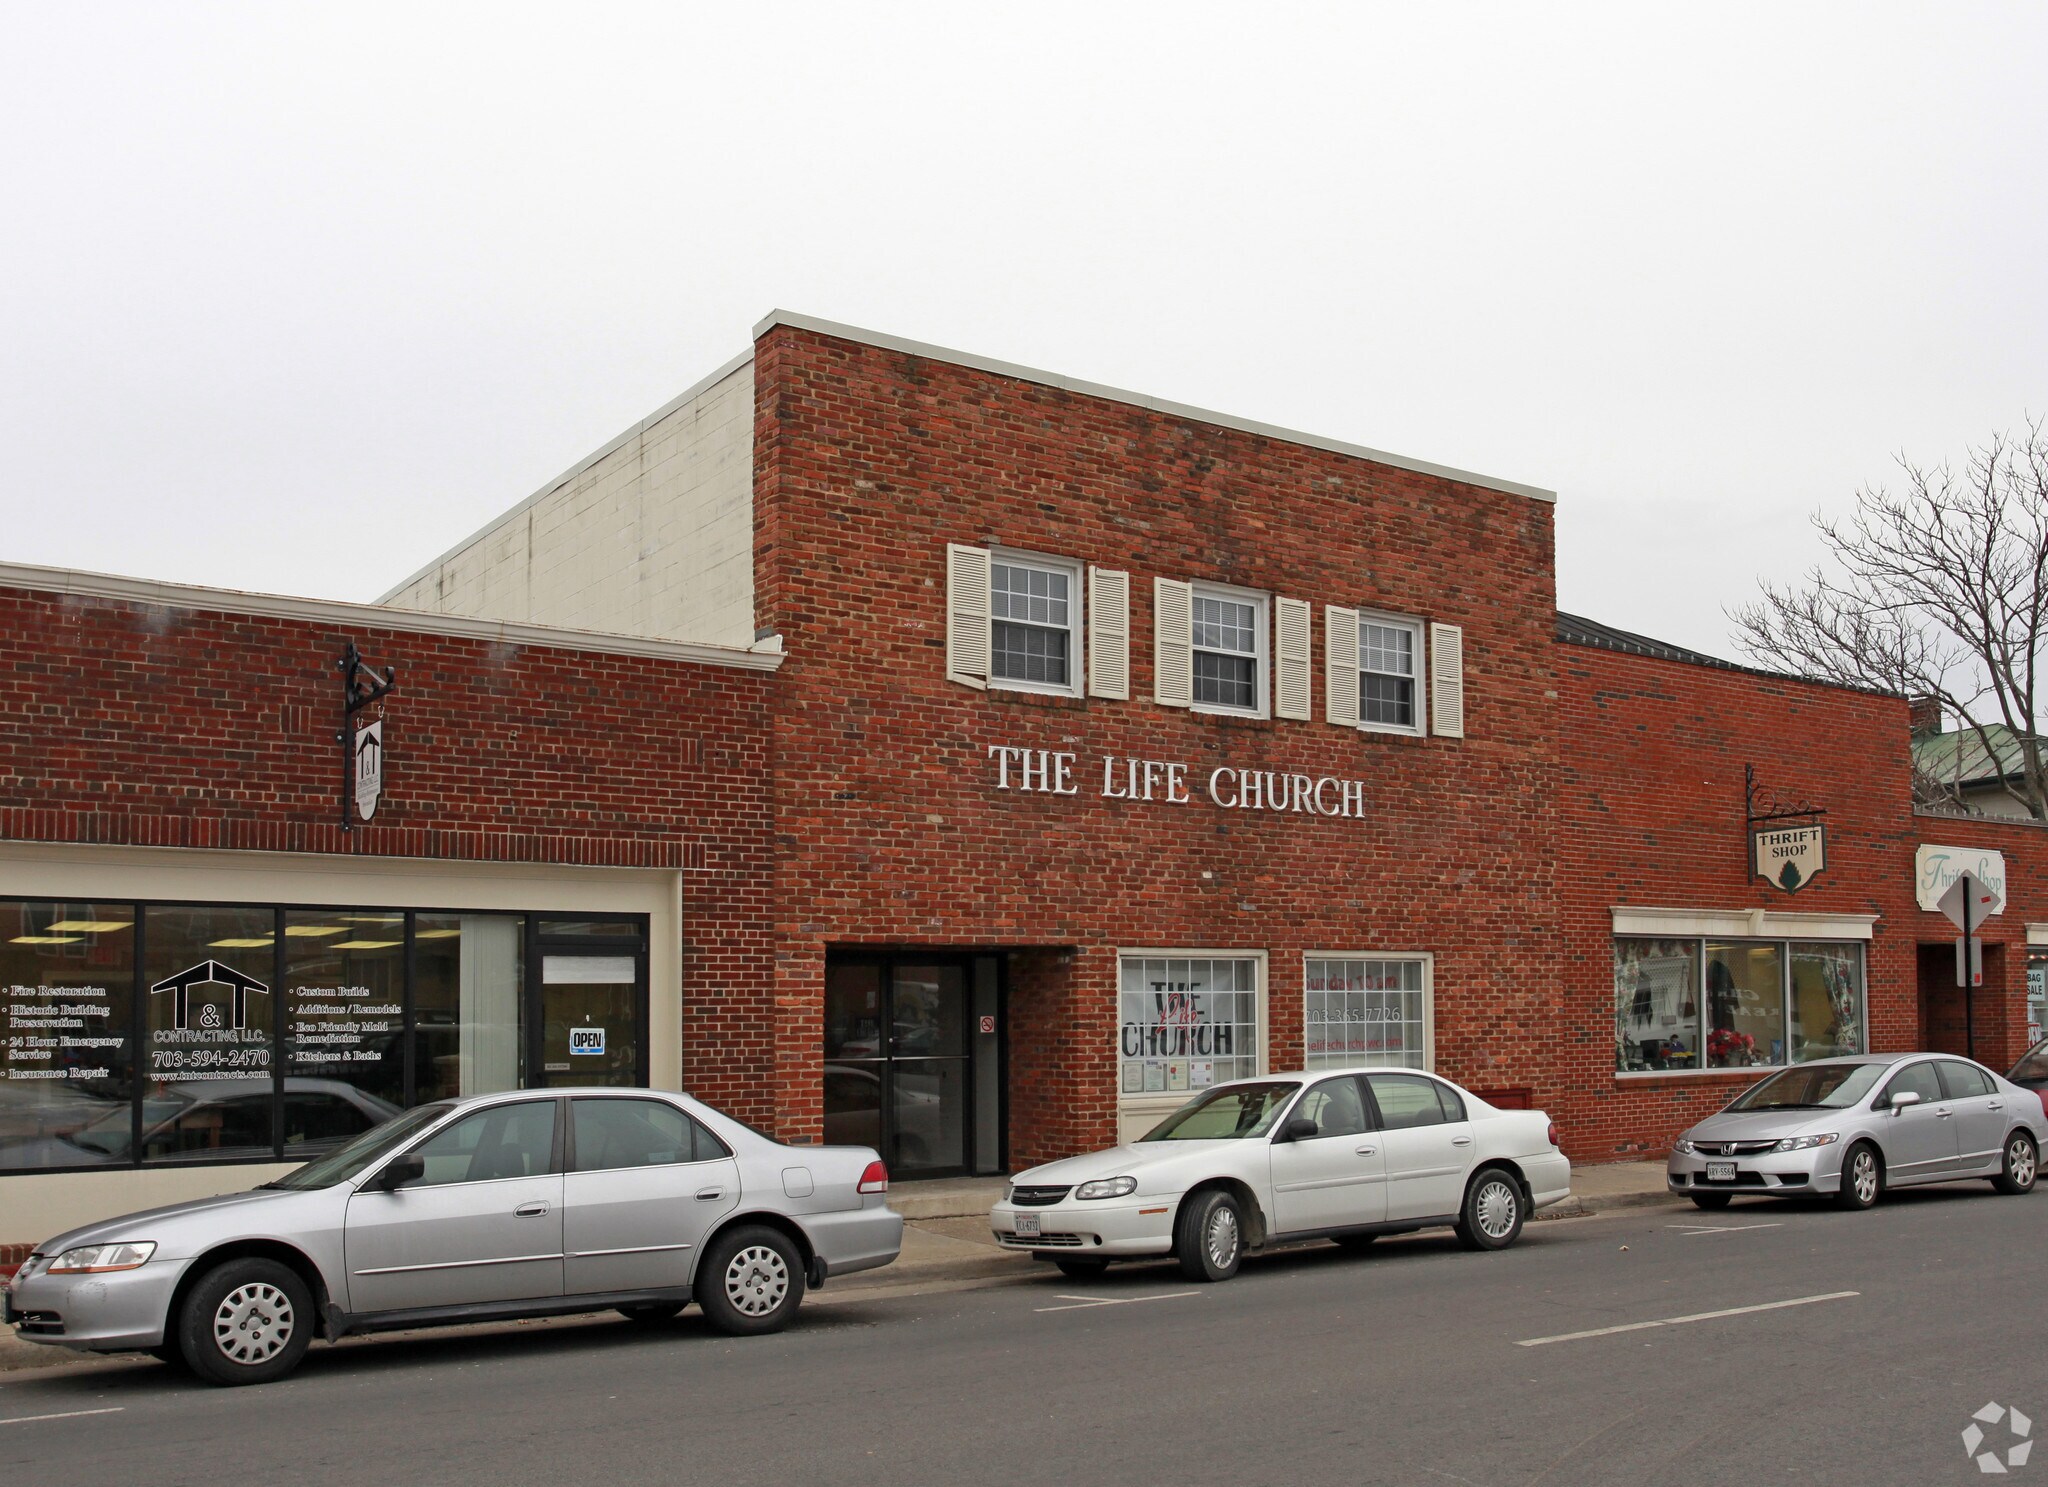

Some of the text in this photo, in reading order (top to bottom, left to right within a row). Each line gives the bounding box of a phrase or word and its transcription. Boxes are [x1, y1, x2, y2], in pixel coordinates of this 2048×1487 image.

[988, 746, 1366, 818] THE LIFE CHURCH
[1759, 830, 1819, 846] THRIFT
[1772, 845, 1807, 858] SHOP
[1921, 854, 1960, 890] Thrif
[1357, 975, 1374, 990] 10
[1376, 976, 1399, 990] am
[2027, 973, 2041, 983] BAG
[10, 985, 107, 996] Fire Restoration
[296, 986, 370, 997] Custom Builds
[1150, 982, 1205, 1015] THE
[10, 1004, 110, 1017] Historic Building
[296, 1004, 346, 1014] Additions
[353, 1004, 402, 1014] Remodels
[9, 1017, 83, 1028] Preservation
[296, 1022, 388, 1033] Eco Friendly Mold
[9, 1036, 124, 1049] 24 Hour Emergency
[153, 1029, 266, 1043] CONTRACTING, LLC.
[296, 1034, 361, 1043] Remediation
[573, 1032, 602, 1048] OPEN
[1121, 1021, 1233, 1057] CHURCH
[9, 1049, 52, 1060] Service
[151, 1050, 270, 1067] 703-594-2470
[296, 1051, 382, 1061] Kitchens & Baths
[8, 1067, 110, 1079] Insurance Repair
[149, 1070, 271, 1081] www.tntcontracts.com
